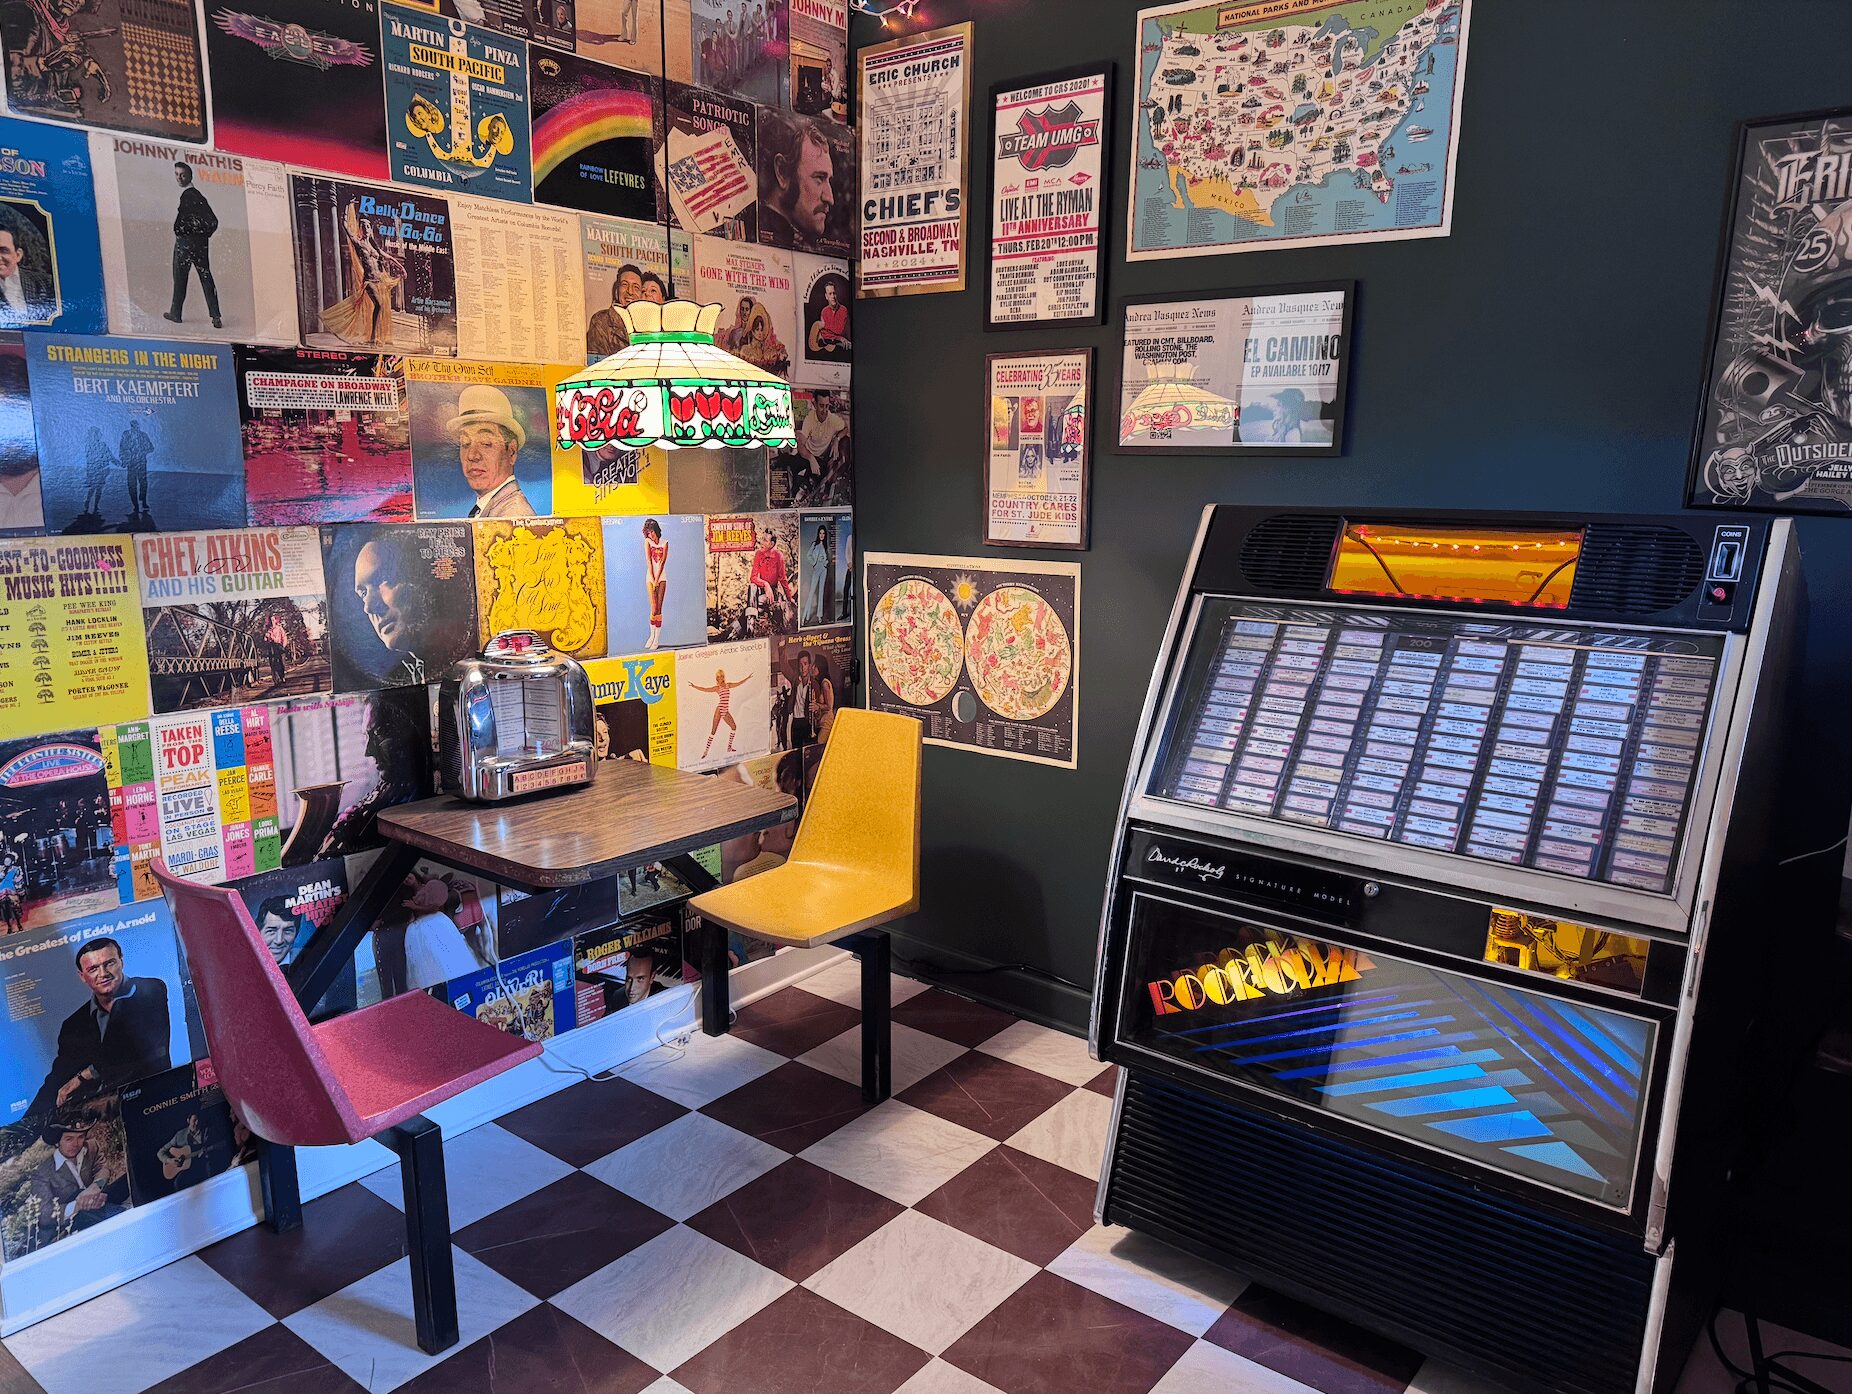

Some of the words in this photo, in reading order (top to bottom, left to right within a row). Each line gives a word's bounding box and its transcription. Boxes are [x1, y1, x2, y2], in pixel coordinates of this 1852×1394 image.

[1224, 9, 1260, 22] NATIONAL
[1263, 3, 1289, 15] PARKS
[1361, 5, 1412, 21] CANADA
[504, 22, 529, 34] PHILCO
[390, 20, 445, 47] MARTIN
[484, 45, 520, 68] PINZA
[413, 46, 455, 69] SOUTH
[458, 58, 502, 81] PACIFIC
[869, 69, 899, 86] ERIC
[904, 55, 960, 77] CHURCH
[893, 74, 932, 88] PRESENTS
[1010, 88, 1043, 103] WELCOME
[1044, 86, 1053, 97] TO
[1054, 83, 1068, 93] CRS
[1069, 78, 1090, 91] 2020!
[692, 99, 750, 126] PATRIOTIC
[692, 116, 728, 135] SONGS
[1014, 131, 1048, 152] TEAM
[1051, 126, 1083, 146] UMG
[113, 138, 179, 160] JOHNNY
[184, 150, 243, 171] MATHIS
[404, 164, 453, 183] COLUMBIA
[604, 168, 645, 189] LEFEVRES
[246, 181, 266, 193] Percy
[267, 182, 285, 194] Faith
[1001, 185, 1020, 194] Capitol
[864, 188, 960, 221] CHIEF'S
[1000, 197, 1019, 222] LIVE
[1021, 194, 1034, 220] AT
[1036, 192, 1054, 217] THE
[1056, 187, 1093, 215] RYMAN
[1210, 193, 1245, 208] MEXICO
[359, 195, 399, 219] Belly
[400, 202, 445, 225] Dance
[1018, 212, 1090, 235] ANNIVERSARY
[586, 227, 628, 246] MARTIN
[631, 234, 660, 251] PINZA
[863, 229, 897, 247] SECOND
[908, 222, 960, 243] BROADWAY
[600, 243, 634, 260] SOUTH
[863, 241, 938, 260] NASHVILLE,
[941, 239, 959, 252] TN
[892, 257, 925, 268] 2024
[700, 265, 723, 280] GONE
[725, 268, 748, 284] WITH
[749, 272, 767, 288] THE
[768, 275, 790, 291] WIND
[1192, 308, 1216, 319] News
[1242, 304, 1276, 316] Andrea
[1279, 302, 1319, 314] Vasquez
[1177, 335, 1215, 344] BILLBOARD,
[297, 350, 347, 360] STEREO
[1135, 344, 1161, 352] ROLLING
[1135, 351, 1178, 360] WASHINGTON
[1244, 338, 1260, 363] EL
[1266, 334, 1341, 363] CAMINO
[47, 344, 129, 365] STRANGERS
[134, 351, 148, 366] IN
[152, 351, 177, 367] THE
[180, 354, 218, 370] NIGHT
[996, 370, 1043, 383] CELEBRATING
[1251, 365, 1261, 377] EP
[1262, 364, 1306, 377] AVAILABLE
[1309, 363, 1330, 376] 10/17
[73, 377, 110, 393] BERT
[117, 380, 200, 398] KAEMPFERT
[253, 377, 318, 388] CHAMPAGNE
[320, 380, 335, 389] ON
[338, 381, 391, 391] BROADWAY
[494, 377, 542, 386] GARDNER
[335, 390, 372, 405] LAWRENCE
[375, 392, 393, 406] WELK
[992, 500, 1039, 510] COUNTRY
[1043, 502, 1077, 511] CARES
[992, 509, 1009, 518] FOR
[1028, 511, 1052, 520] JUDE
[1055, 513, 1077, 521] KIDS
[726, 530, 753, 541] REEVES
[142, 535, 197, 578] CHET
[206, 533, 283, 574] ATKINS
[5, 573, 55, 600] MUSIC
[147, 578, 182, 598] AND
[189, 576, 216, 595] HIS
[221, 571, 284, 593] GUITAR
[80, 601, 97, 609] WEE
[66, 618, 86, 626] HANK
[88, 616, 117, 624] LOCKLIN
[85, 631, 119, 639] REEVES
[68, 686, 95, 695] PORTER
[97, 682, 129, 691] WAGONER
[622, 659, 670, 704] Kaye
[246, 716, 264, 728] HIRT
[161, 725, 202, 743] TAKEN
[215, 724, 240, 736] REESE
[118, 732, 149, 744] MARGRET
[163, 744, 204, 768] TOP
[43, 760, 60, 768] LIVE
[37, 769, 65, 779] OPERA
[160, 769, 210, 787] PEAK
[219, 775, 245, 787] PEERCE
[249, 771, 273, 784] CARLE
[125, 791, 155, 806] HORNE
[162, 790, 203, 801] RECORDED
[174, 808, 205, 818] PERSON
[166, 834, 183, 842] LAS
[187, 827, 216, 838] VEGAS
[185, 822, 215, 832] STAGE
[254, 828, 278, 839] PRIMA
[225, 830, 250, 843] JONES
[131, 849, 160, 862] MARTIN
[182, 859, 219, 874] WALDORF
[298, 879, 332, 896] DEAN
[1235, 874, 1302, 895] SIGNATURE
[1313, 892, 1351, 906] MODEL
[285, 886, 341, 908] MARTIN'S
[0, 951, 14, 961] he
[15, 934, 69, 957] Greatest
[69, 932, 81, 942] of
[83, 924, 114, 939] Eddy
[115, 912, 156, 931] Arnold
[586, 938, 622, 960] ROGER
[623, 921, 672, 948] WILLIAMS
[587, 958, 606, 974] BORN
[607, 951, 626, 966] FREE
[122, 1088, 141, 1100] RCA
[143, 1096, 179, 1115] CONNIE
[180, 1086, 208, 1102] SMITH
[10, 1100, 28, 1109] RCA
